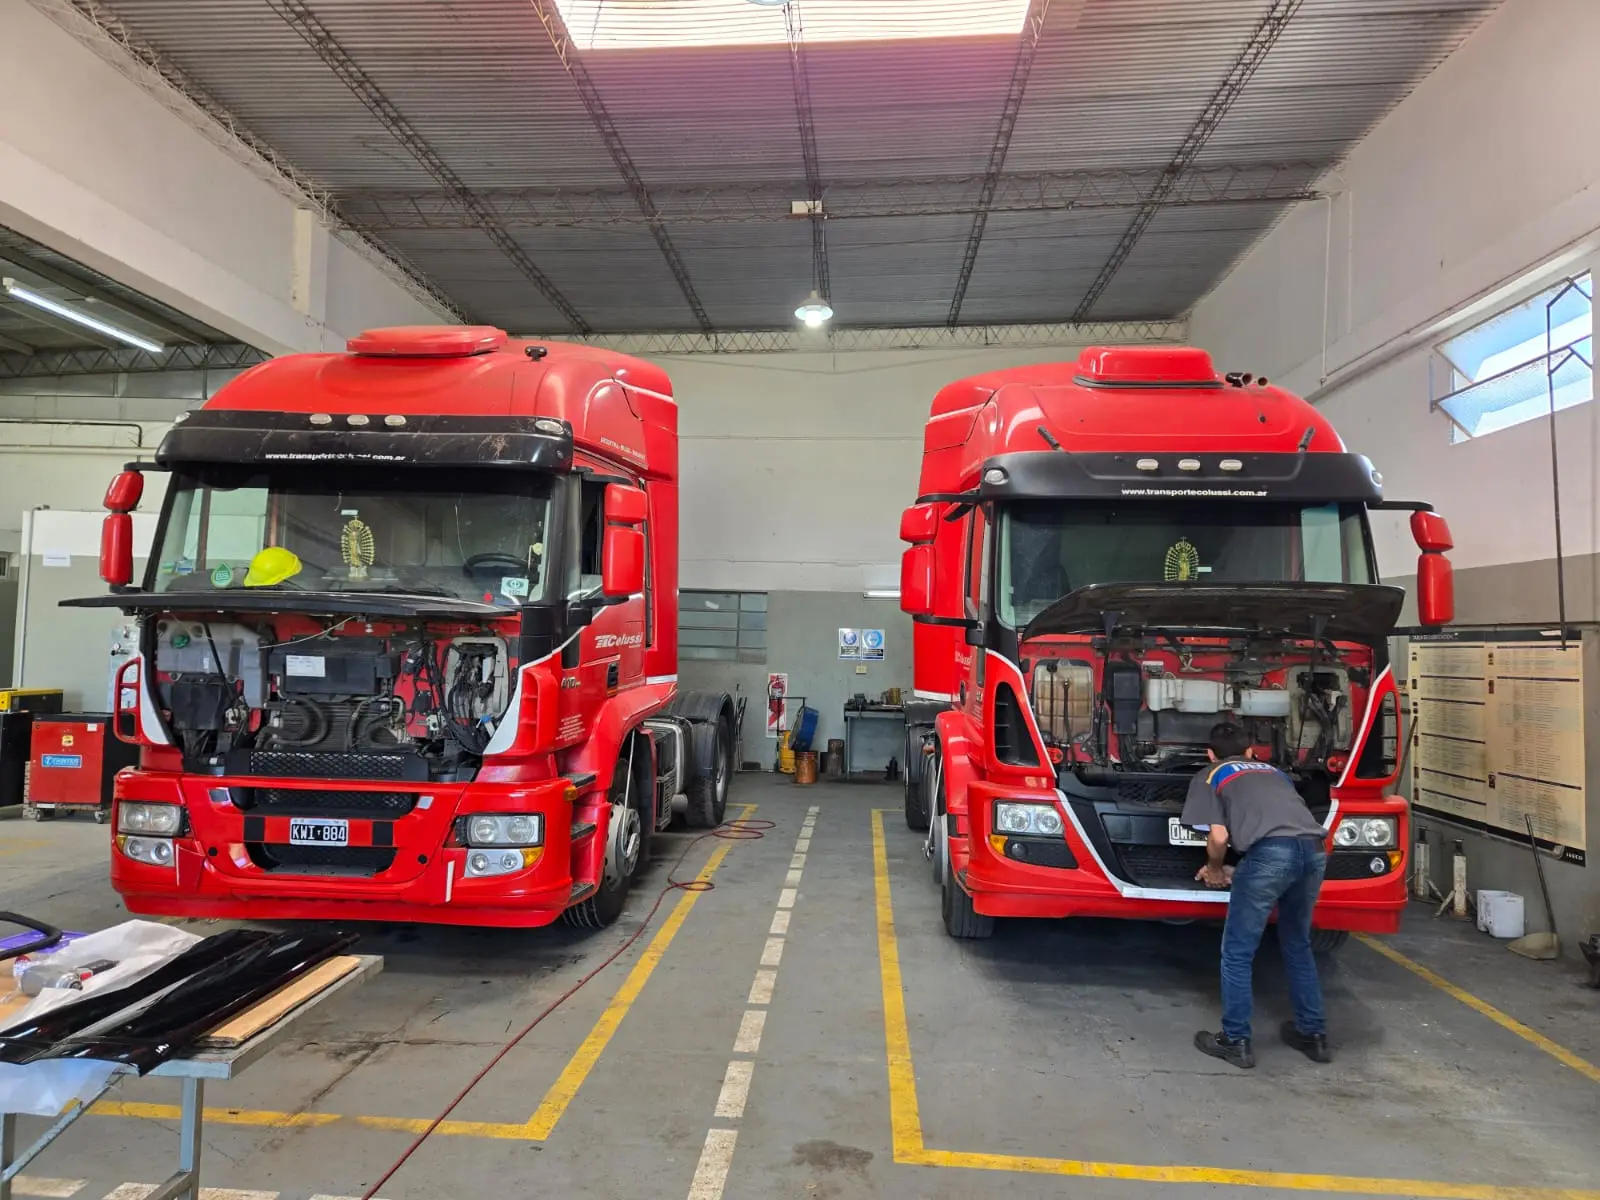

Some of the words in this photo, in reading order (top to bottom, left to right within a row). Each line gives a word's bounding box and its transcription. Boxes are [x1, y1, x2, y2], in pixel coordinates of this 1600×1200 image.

[1121, 488, 1268, 497] www.transportecolussi.com.ar
[292, 825, 315, 840] KWI
[323, 826, 346, 841] 884
